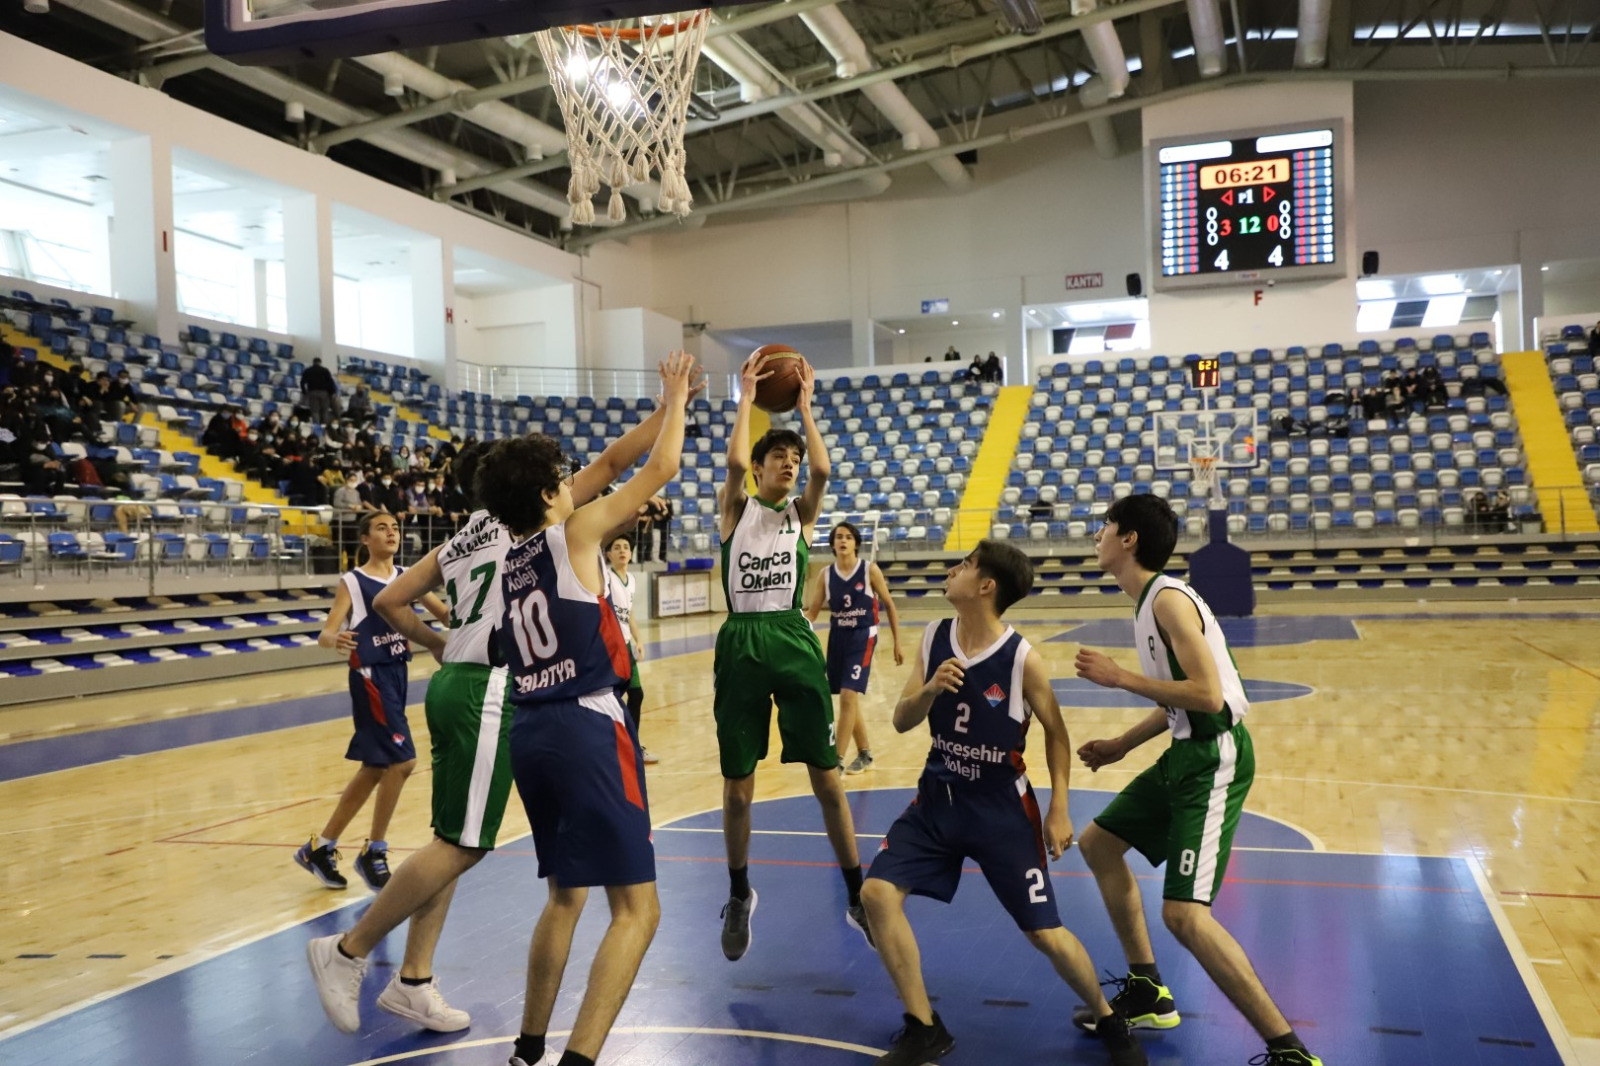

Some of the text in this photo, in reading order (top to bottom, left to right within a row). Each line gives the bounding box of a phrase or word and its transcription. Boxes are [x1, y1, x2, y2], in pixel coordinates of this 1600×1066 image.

[1215, 164, 1277, 185] 06:21
[1220, 219, 1232, 236] 3
[1239, 216, 1261, 234] 12
[1267, 215, 1279, 232] 0
[1214, 249, 1229, 271] 4
[1268, 244, 1283, 267] 4
[1254, 290, 1263, 306] F
[446, 307, 453, 325] H
[1200, 371, 1217, 387] 11
[446, 560, 497, 630] 17
[843, 594, 852, 608] 3
[509, 589, 559, 668] 10
[850, 664, 862, 680] 3
[954, 702, 971, 734] 2
[1179, 849, 1196, 876] 8
[1025, 867, 1048, 904] 2
